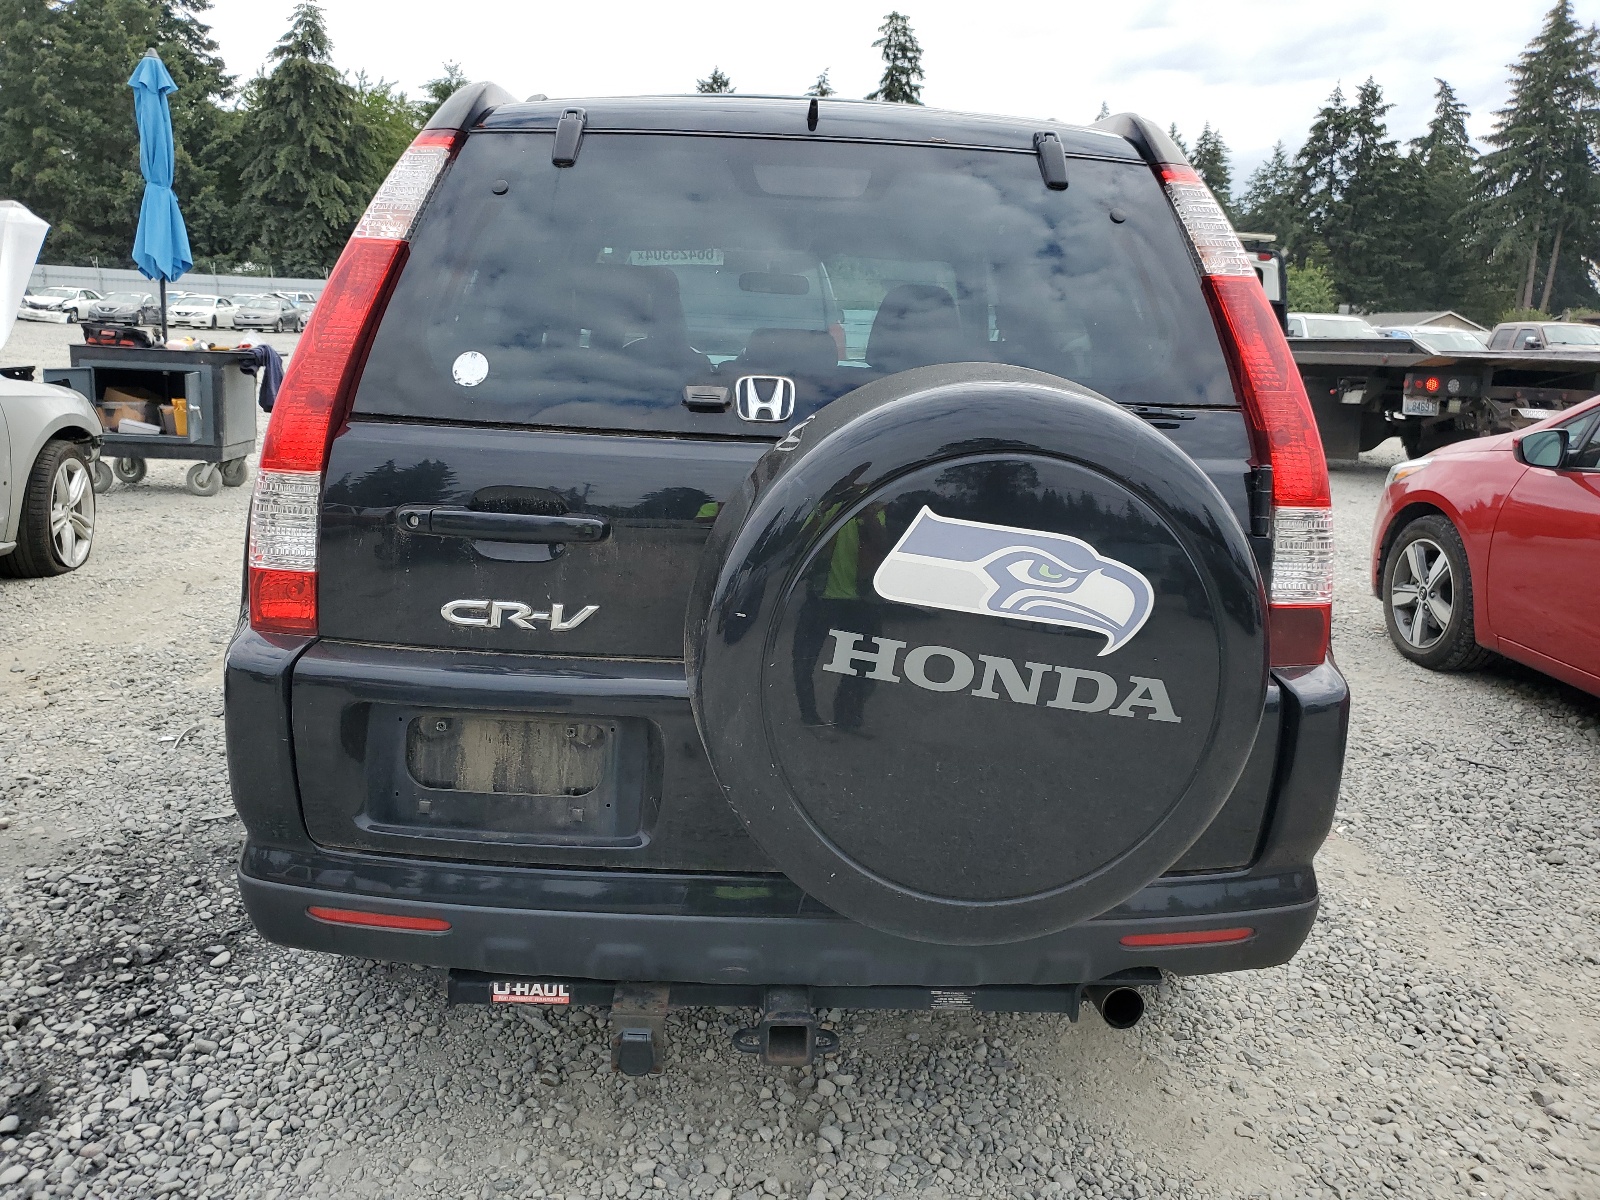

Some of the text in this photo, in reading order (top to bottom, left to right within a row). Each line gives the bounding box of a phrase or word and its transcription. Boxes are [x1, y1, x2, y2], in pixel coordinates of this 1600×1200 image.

[441, 599, 600, 632] CR-V
[822, 628, 1182, 723] HONDA
[494, 982, 570, 996] U-HAUL
